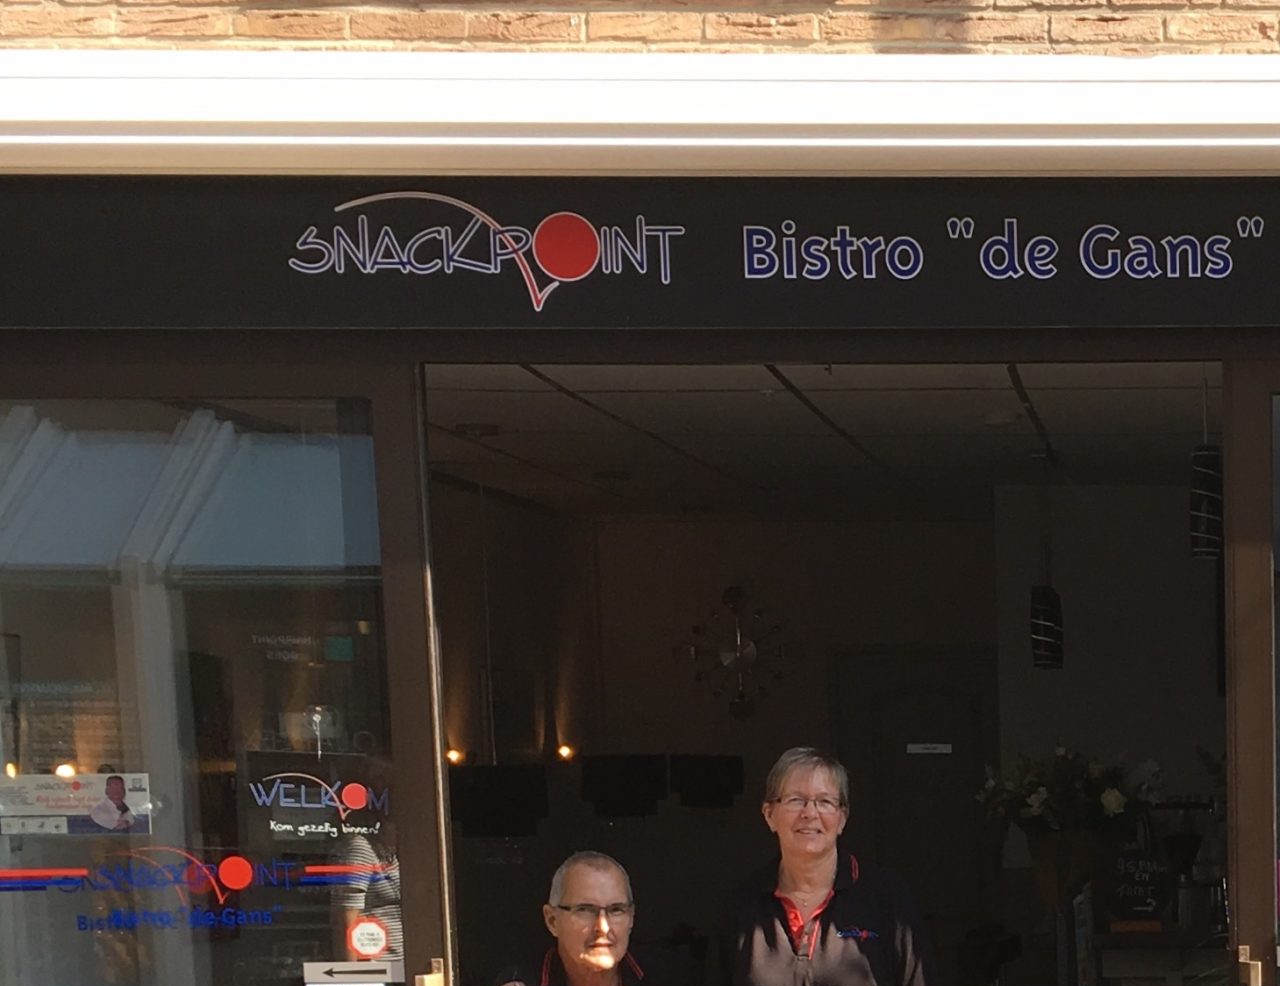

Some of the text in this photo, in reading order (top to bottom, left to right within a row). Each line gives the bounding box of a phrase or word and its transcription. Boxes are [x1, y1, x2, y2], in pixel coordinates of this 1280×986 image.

[288, 208, 686, 286] SNACKPOINT
[743, 216, 1265, 280] Bistro "de Gans"
[249, 777, 390, 816] WELKOM
[269, 820, 294, 833] Kom
